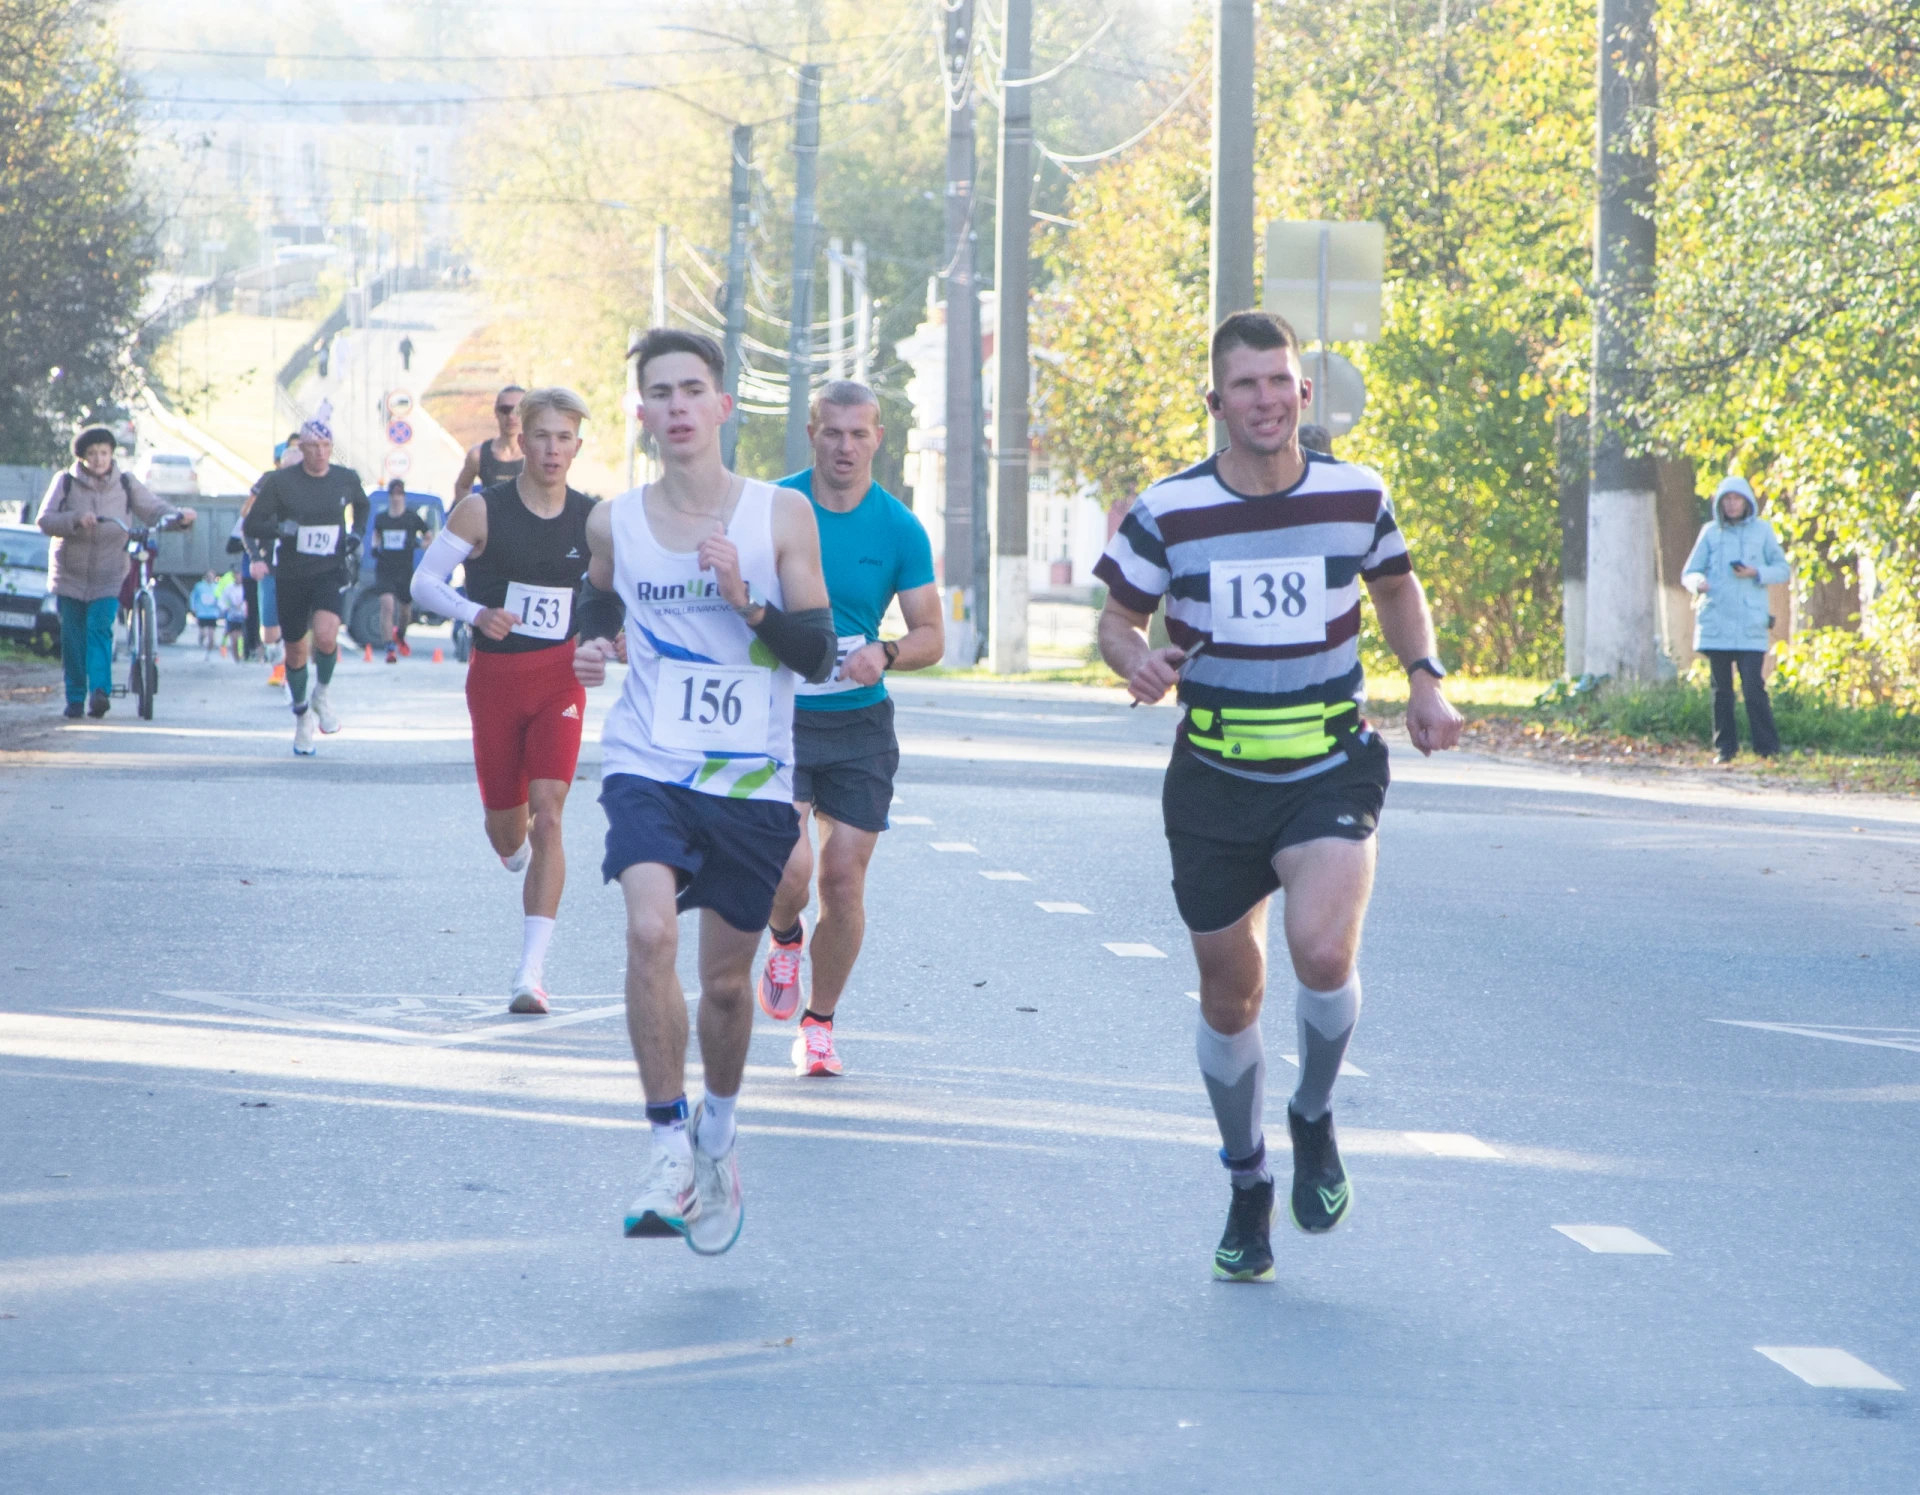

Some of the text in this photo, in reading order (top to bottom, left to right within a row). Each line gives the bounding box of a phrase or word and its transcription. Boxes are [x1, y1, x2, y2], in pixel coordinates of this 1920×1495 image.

[307, 533, 330, 549] 129
[637, 578, 750, 601] Run4f
[1227, 571, 1307, 619] 138
[521, 596, 560, 629] 153
[655, 608, 671, 616] RUN
[672, 606, 695, 615] CLUB
[678, 676, 744, 726] 156
